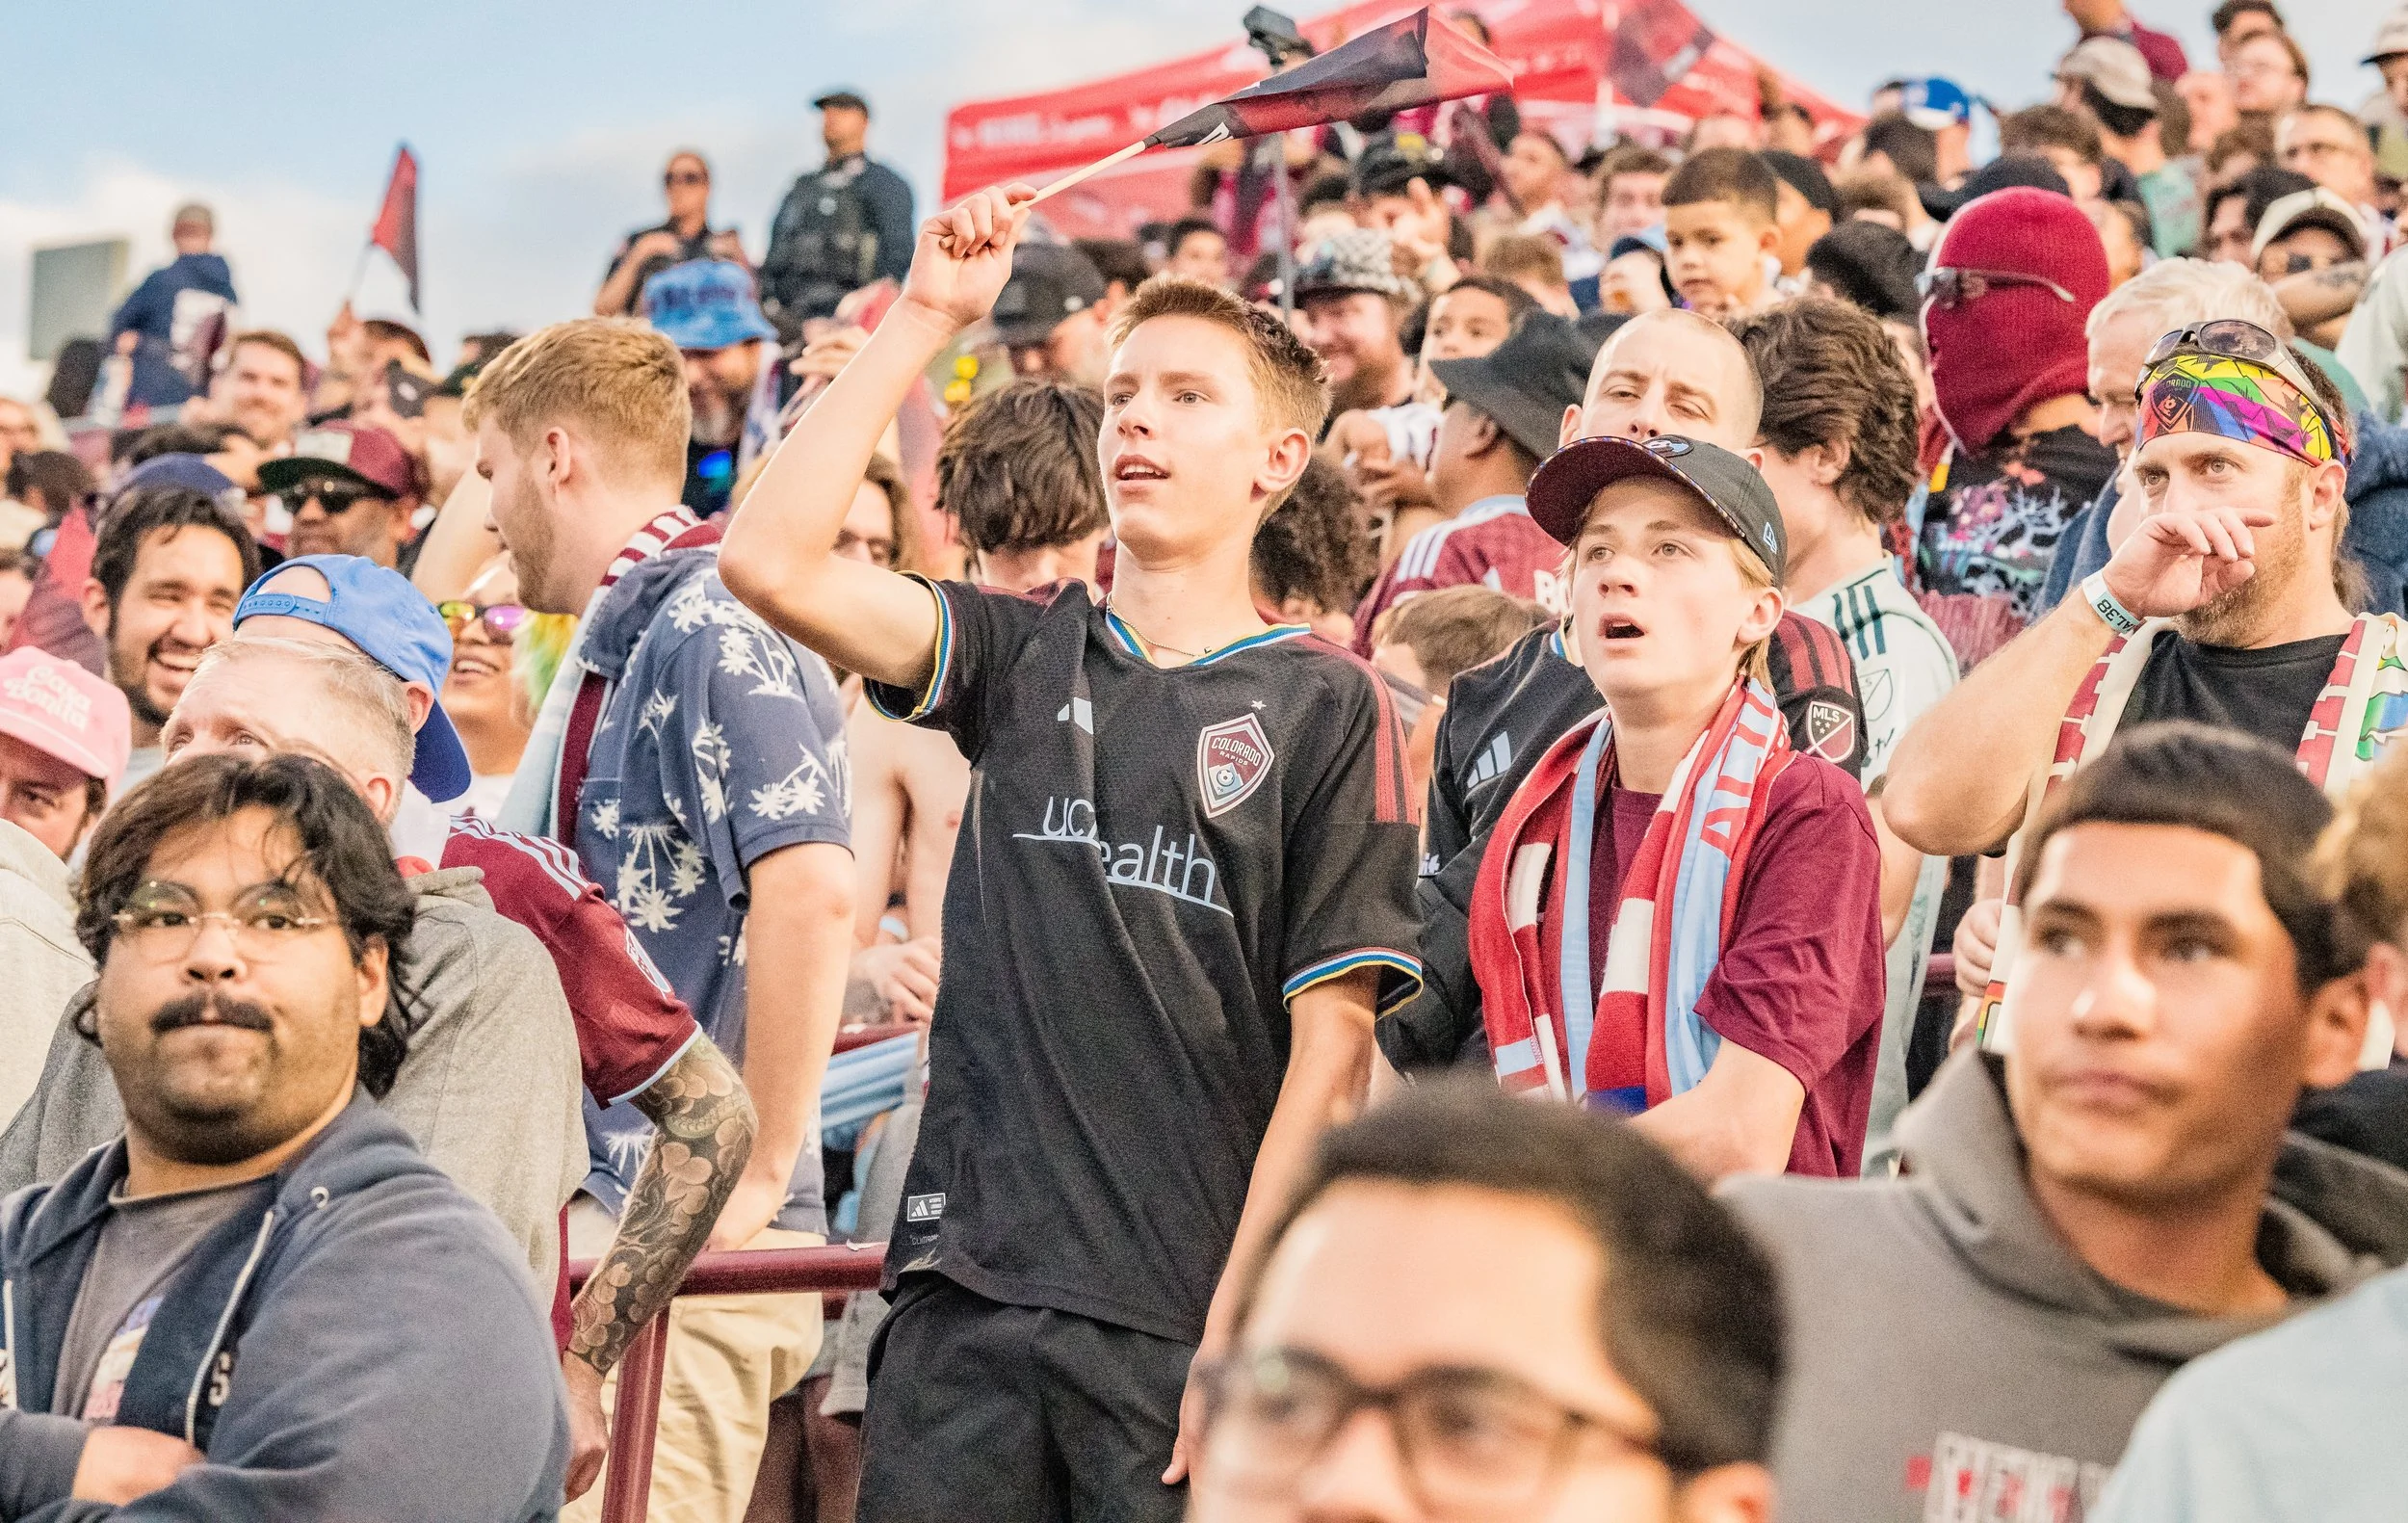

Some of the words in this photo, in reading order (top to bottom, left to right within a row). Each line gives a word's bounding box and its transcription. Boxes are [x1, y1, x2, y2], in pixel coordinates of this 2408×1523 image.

[2097, 598, 2135, 632] AL38
[1813, 706, 1841, 723] MLS
[1212, 737, 1262, 767] COLORADO
[1219, 750, 1248, 766] RAPIDS
